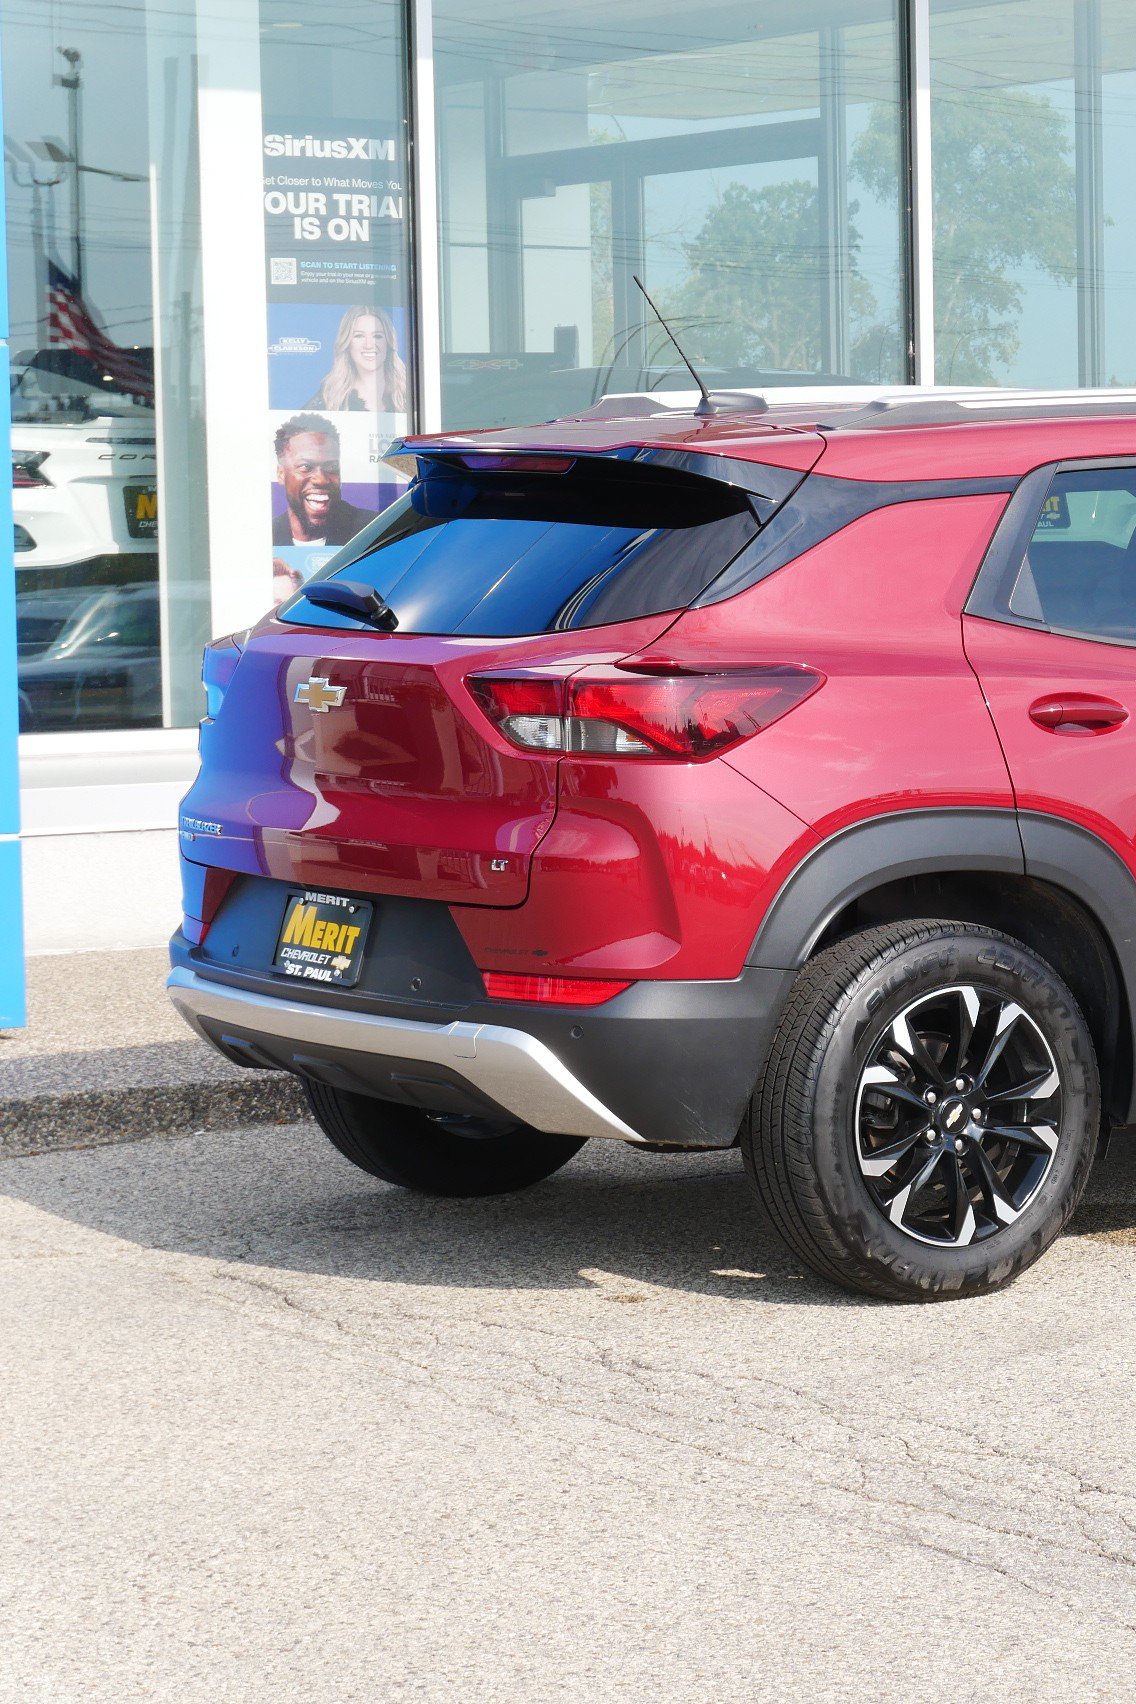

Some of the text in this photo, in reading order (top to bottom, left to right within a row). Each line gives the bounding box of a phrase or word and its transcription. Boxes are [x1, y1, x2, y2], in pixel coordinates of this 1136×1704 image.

[264, 134, 395, 161] SiriusXM
[277, 175, 309, 187] Closer
[312, 176, 322, 187] to
[323, 176, 350, 188] What
[352, 179, 383, 189] Moves
[263, 191, 327, 215] OUR
[294, 216, 369, 242] IS ON
[300, 261, 321, 269] SCAN
[334, 262, 357, 270] START
[491, 859, 509, 871] LT
[304, 891, 350, 907] MERIT
[282, 903, 361, 955] MERIT
[280, 947, 332, 965] CHEVROLET
[286, 964, 333, 982] ST. PAUL
